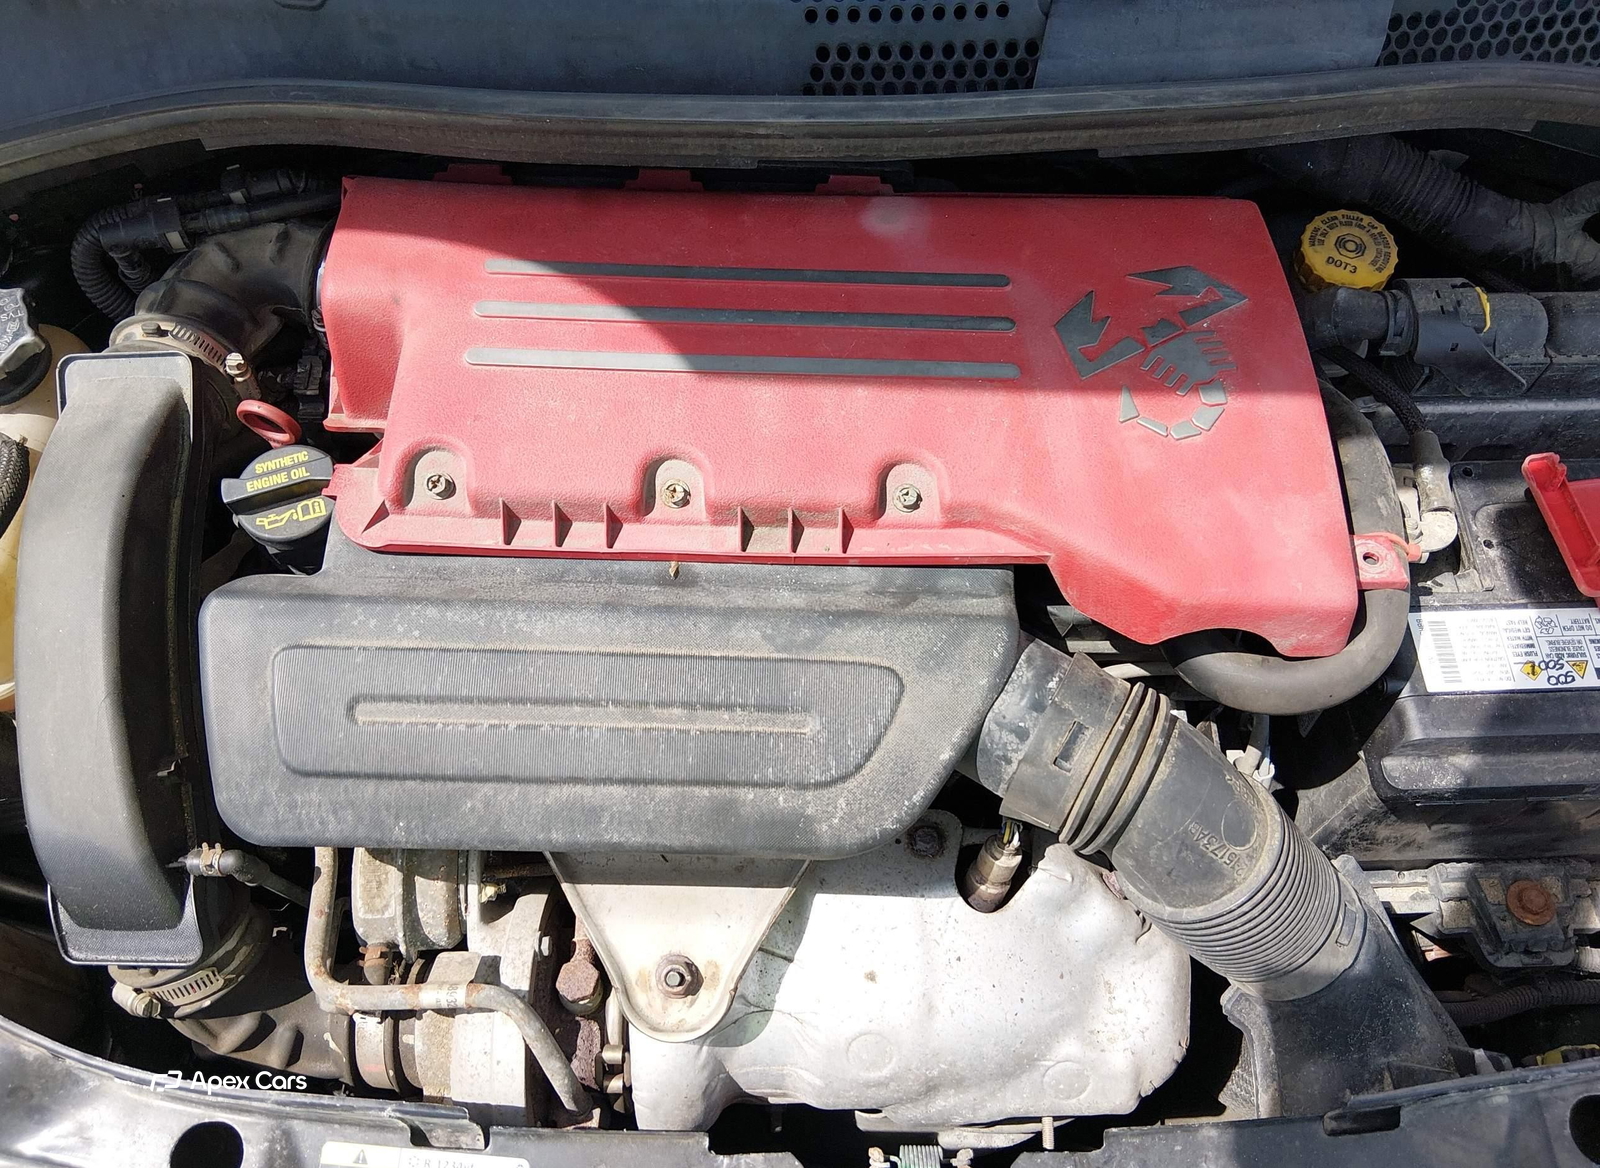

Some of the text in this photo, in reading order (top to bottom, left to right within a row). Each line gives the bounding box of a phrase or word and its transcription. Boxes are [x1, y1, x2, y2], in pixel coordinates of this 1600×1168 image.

[1326, 256, 1357, 274] DOT3
[255, 451, 308, 474] SYNTHETIC
[246, 467, 310, 492] ENGINE OIL
